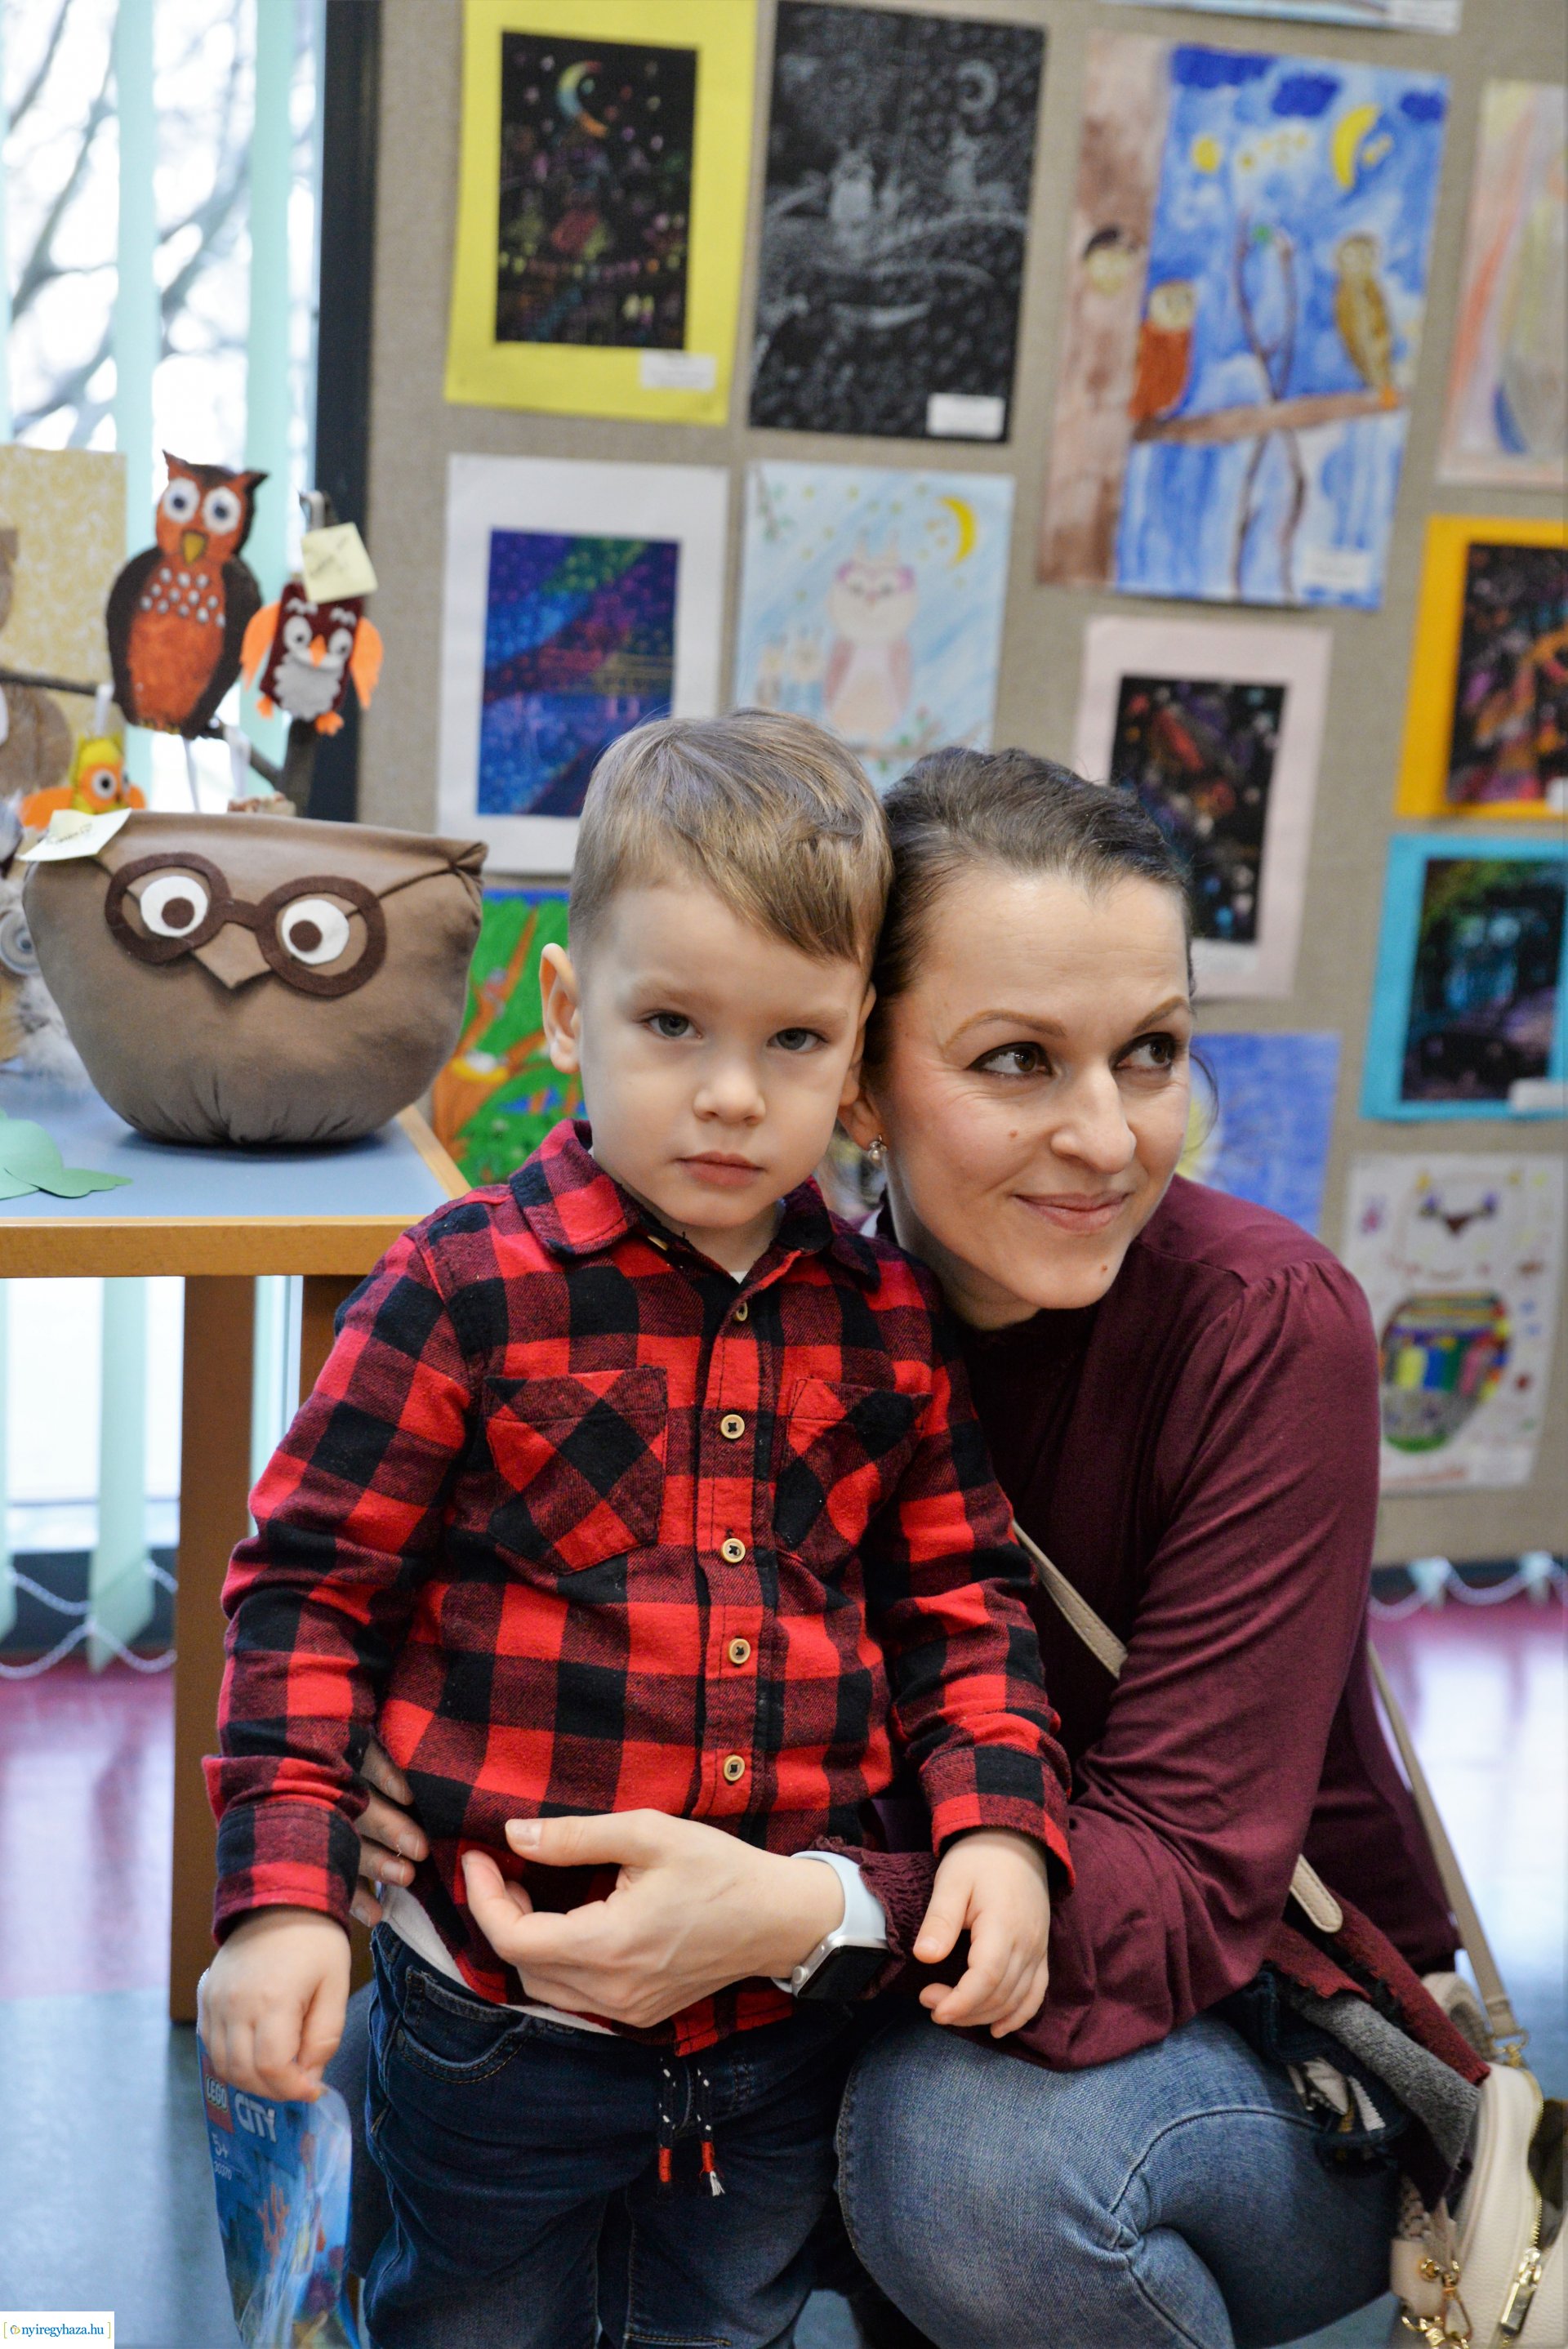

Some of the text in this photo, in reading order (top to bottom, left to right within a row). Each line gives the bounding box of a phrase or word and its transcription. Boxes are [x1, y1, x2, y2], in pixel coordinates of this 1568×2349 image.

[206, 2075, 276, 2143] LEGO CITY
[212, 2133, 228, 2158] 5+
